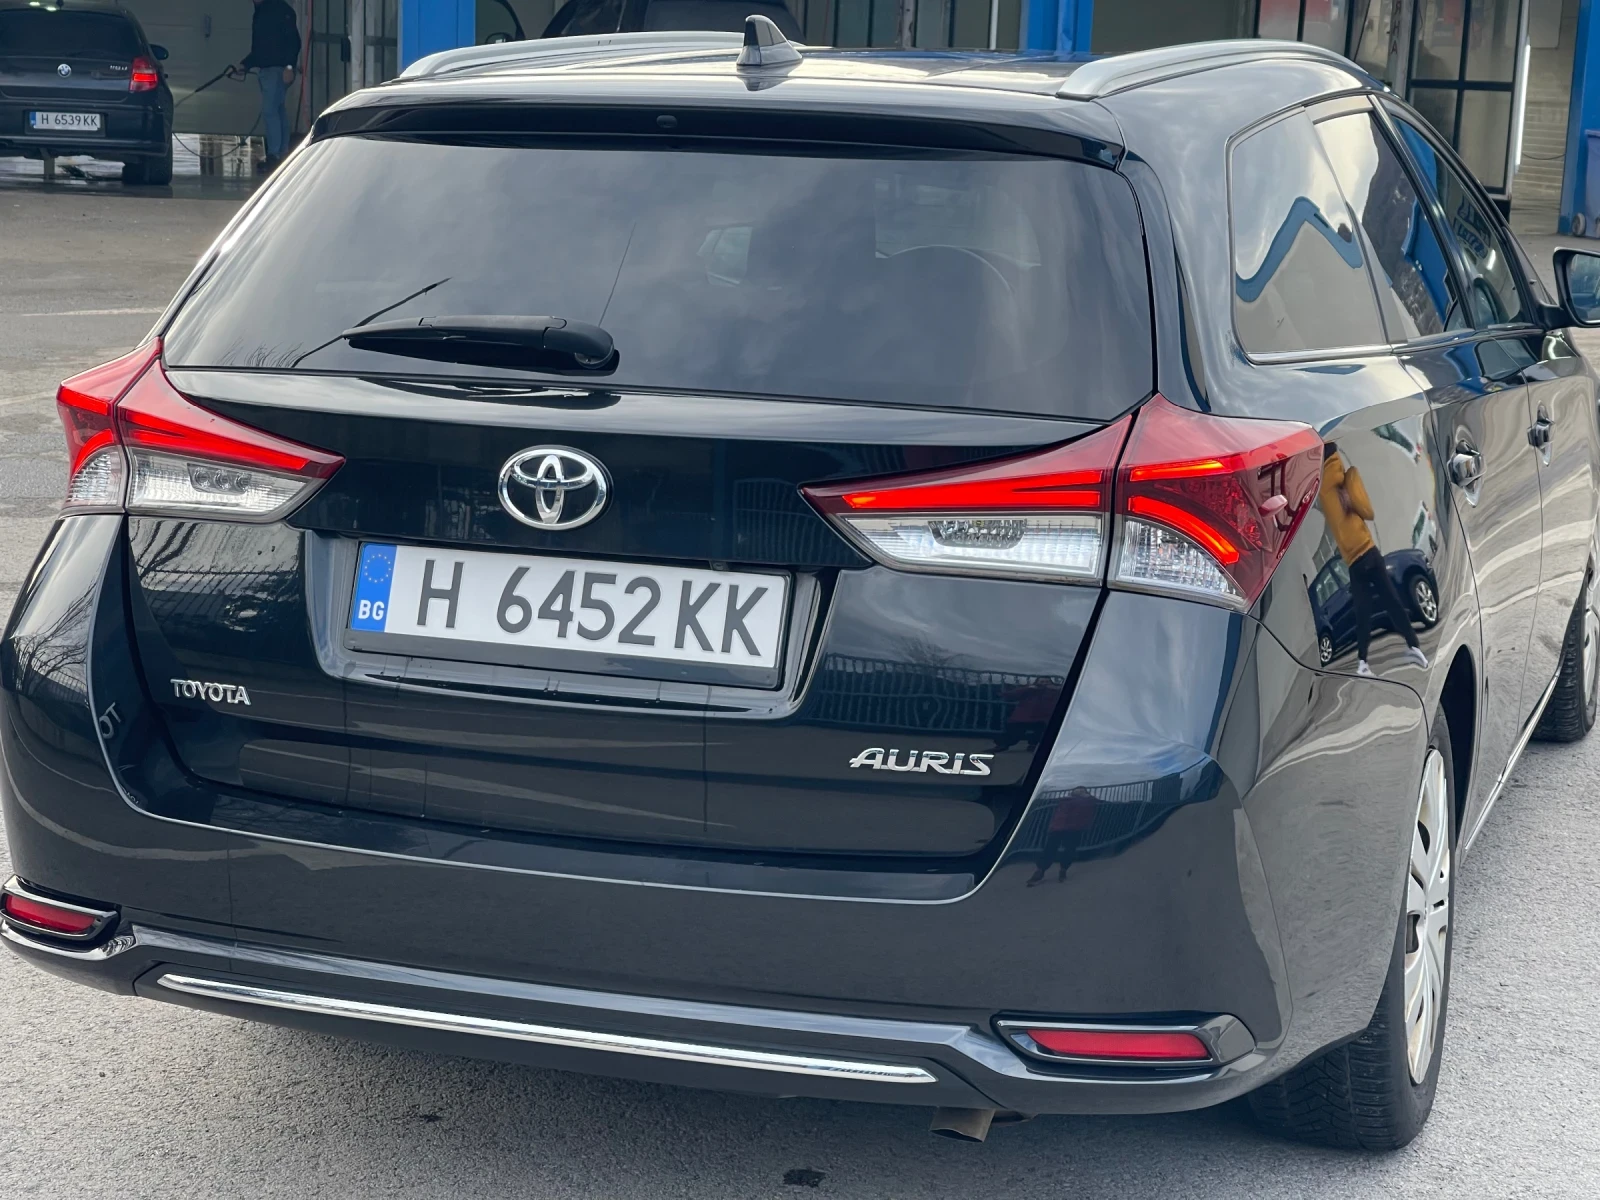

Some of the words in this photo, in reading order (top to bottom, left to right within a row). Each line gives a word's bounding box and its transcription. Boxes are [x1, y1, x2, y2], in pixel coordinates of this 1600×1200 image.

[41, 113, 49, 125] H
[357, 599, 385, 621] BG
[416, 558, 465, 629] H
[496, 565, 663, 647] 6452
[673, 579, 769, 657] KK
[170, 678, 252, 706] TOYOTA
[849, 747, 995, 776] AURIS
